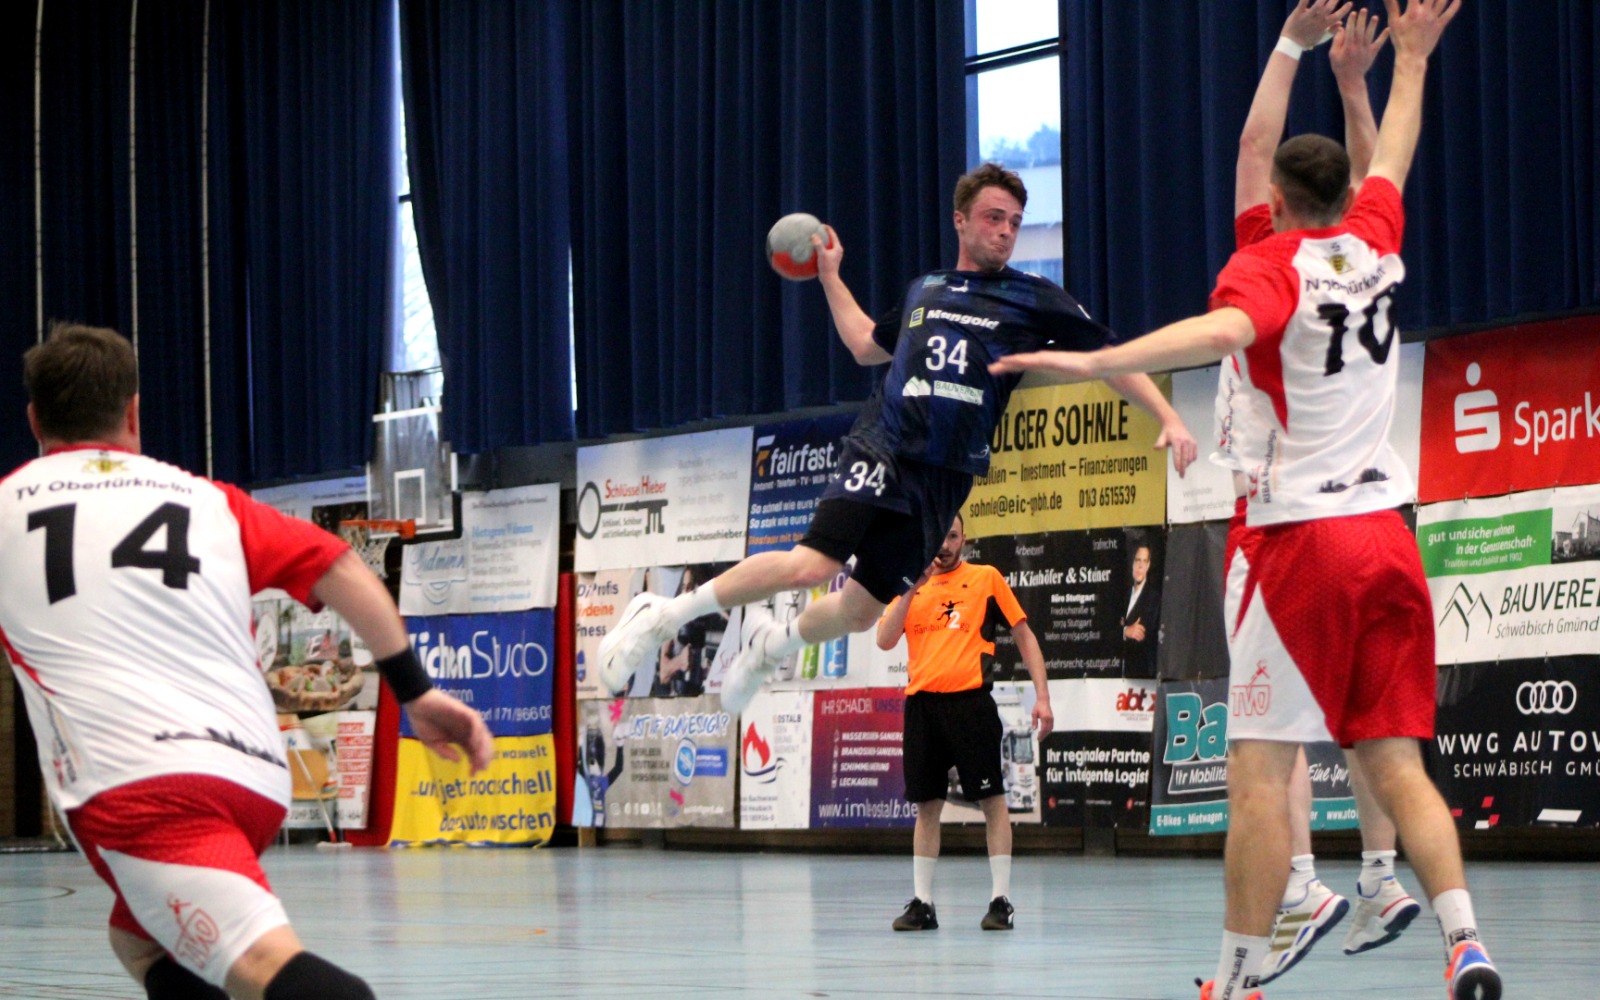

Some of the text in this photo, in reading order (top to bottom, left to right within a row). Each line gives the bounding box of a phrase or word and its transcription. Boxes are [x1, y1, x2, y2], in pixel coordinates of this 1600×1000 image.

[926, 309, 1000, 331] Mangold
[1316, 281, 1402, 377] 10
[925, 335, 969, 375] 34
[990, 399, 1130, 454] OLGER SOHNLE
[844, 461, 886, 496] 34
[16, 483, 41, 500] TV
[1099, 485, 1136, 506] 6515539
[1428, 531, 1446, 546] gut
[1449, 528, 1467, 540] und
[1468, 526, 1493, 539] sicher
[27, 501, 201, 606] 14
[1456, 543, 1464, 555] in
[1464, 542, 1478, 554] der
[1066, 567, 1077, 584] &
[1500, 577, 1600, 615] BAUVERE
[948, 611, 960, 629] 2
[1495, 619, 1554, 640] Schwäbisch
[1437, 732, 1500, 755] WWG
[1046, 748, 1061, 763] Ihr
[1111, 748, 1151, 764] Partne
[1046, 767, 1063, 783] für
[1454, 759, 1552, 778] SCHWÄBISCH
